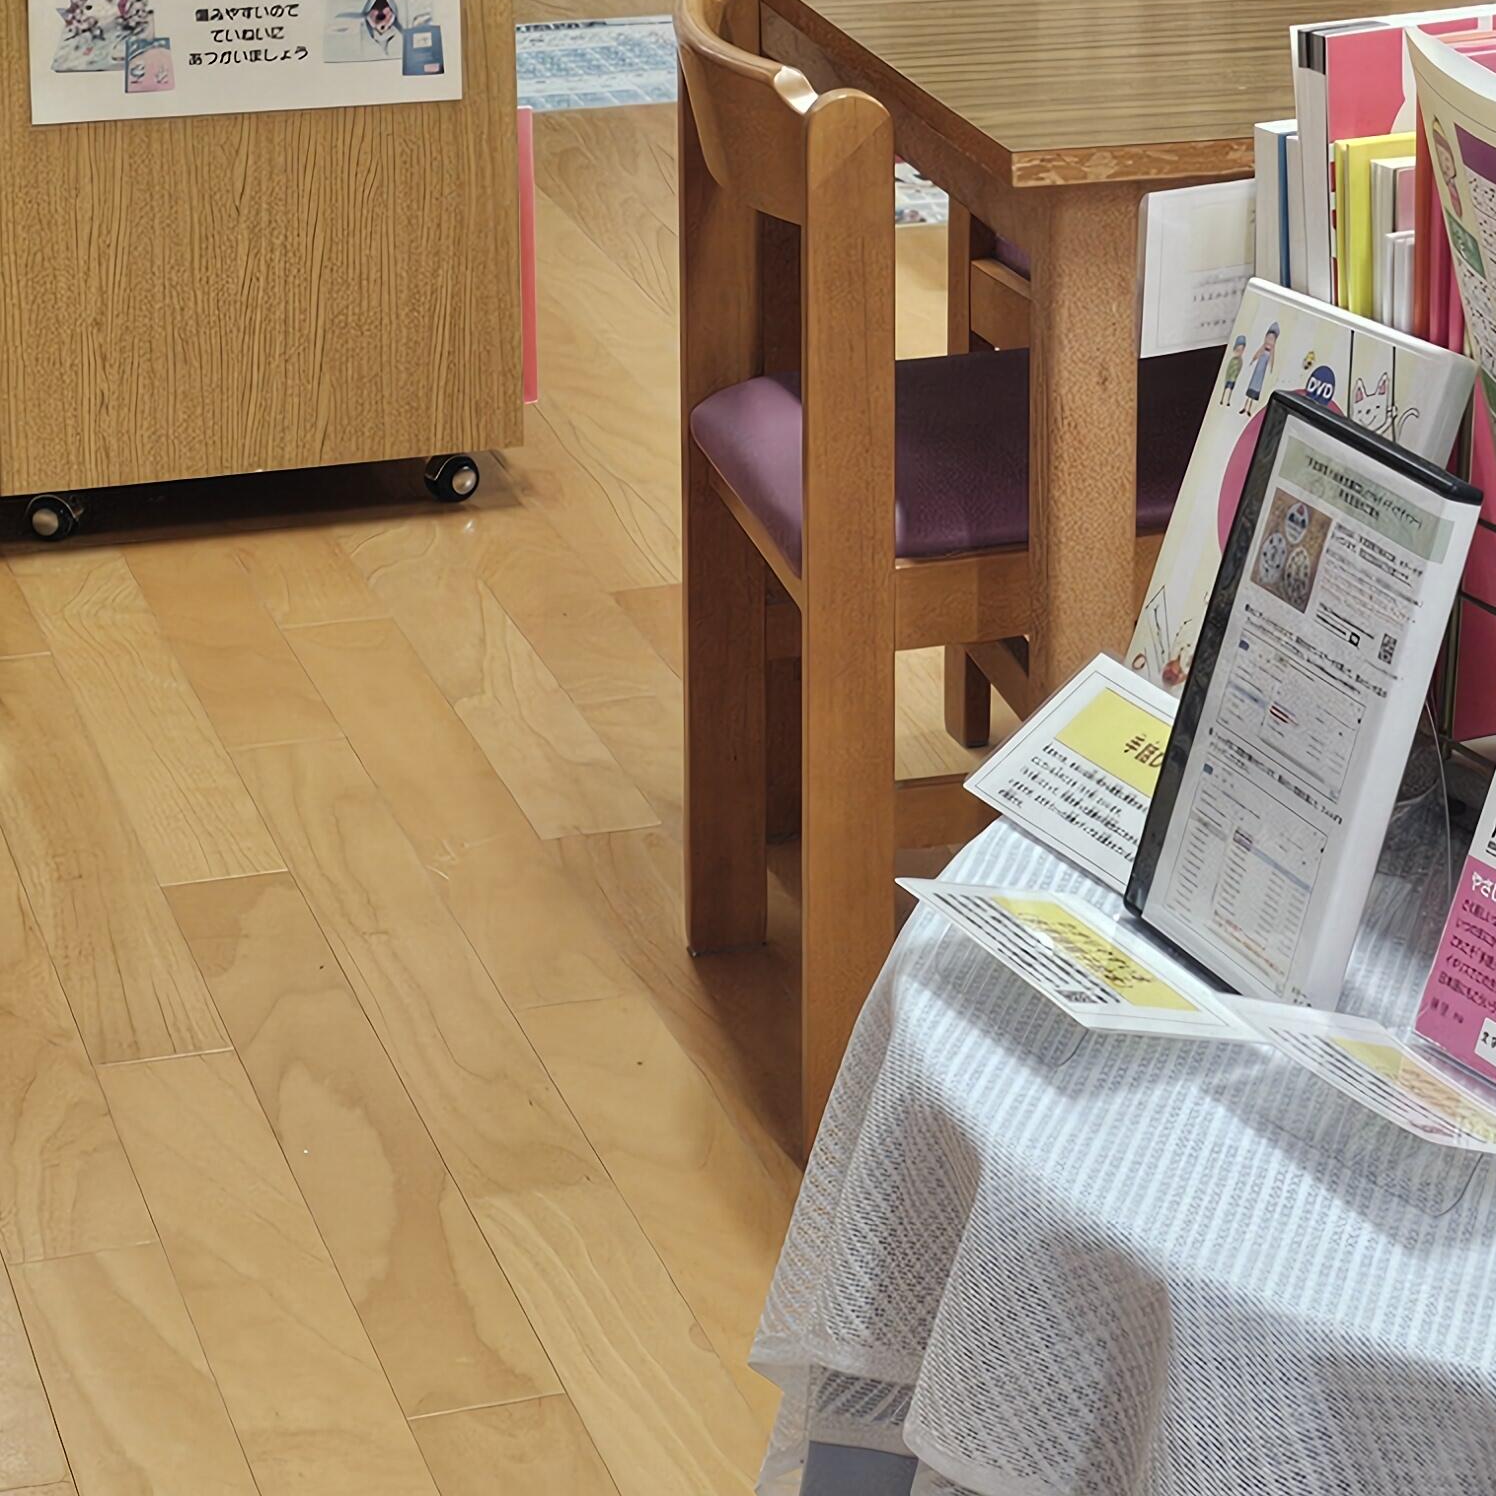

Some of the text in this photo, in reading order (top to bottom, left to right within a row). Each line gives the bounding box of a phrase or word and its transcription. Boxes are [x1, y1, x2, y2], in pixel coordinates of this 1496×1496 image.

[210, 25, 285, 42] ていねいに
[188, 46, 310, 66] あつかいましょう
[1306, 375, 1334, 401] DVD
